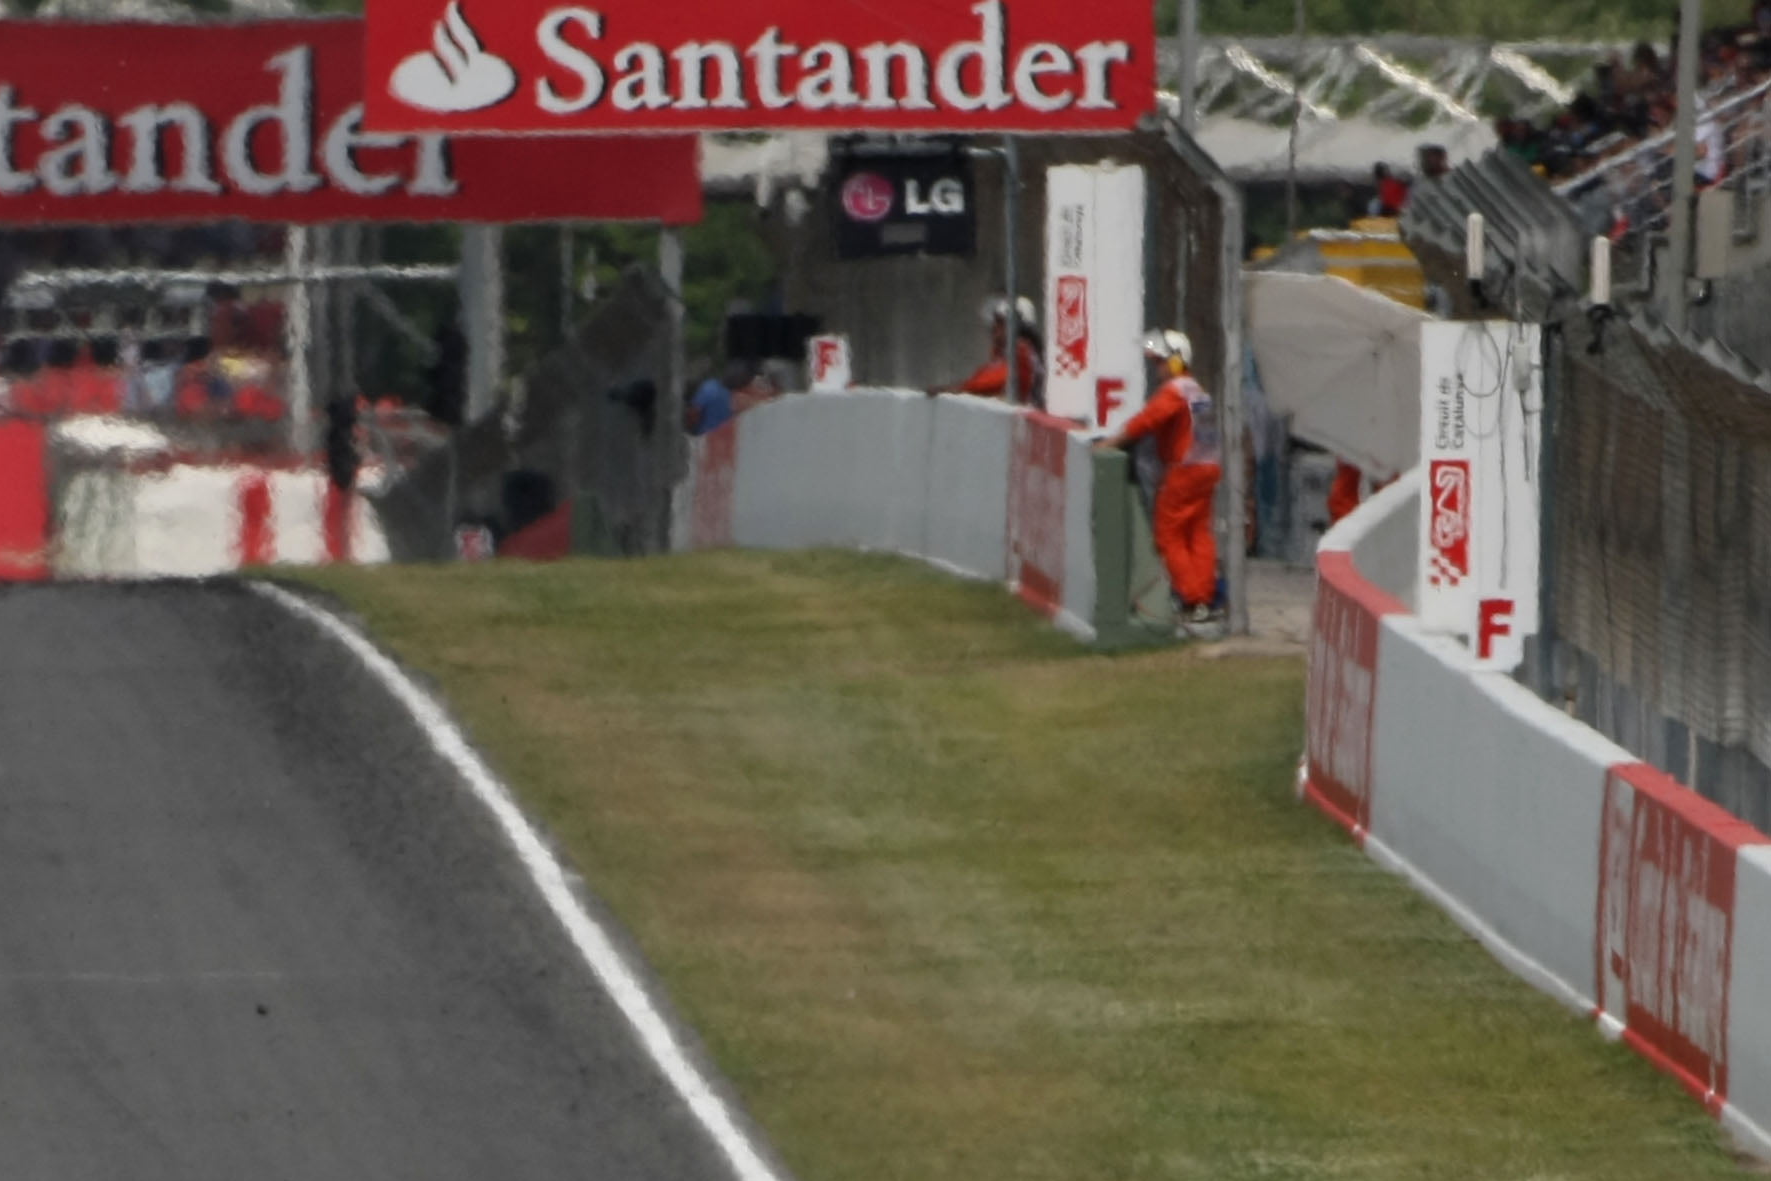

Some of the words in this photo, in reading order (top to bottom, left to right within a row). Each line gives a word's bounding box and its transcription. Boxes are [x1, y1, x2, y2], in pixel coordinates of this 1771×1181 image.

[535, 0, 1130, 112] Santander
[905, 178, 964, 215] LG
[1095, 379, 1125, 427] F
[1479, 600, 1515, 659] F
